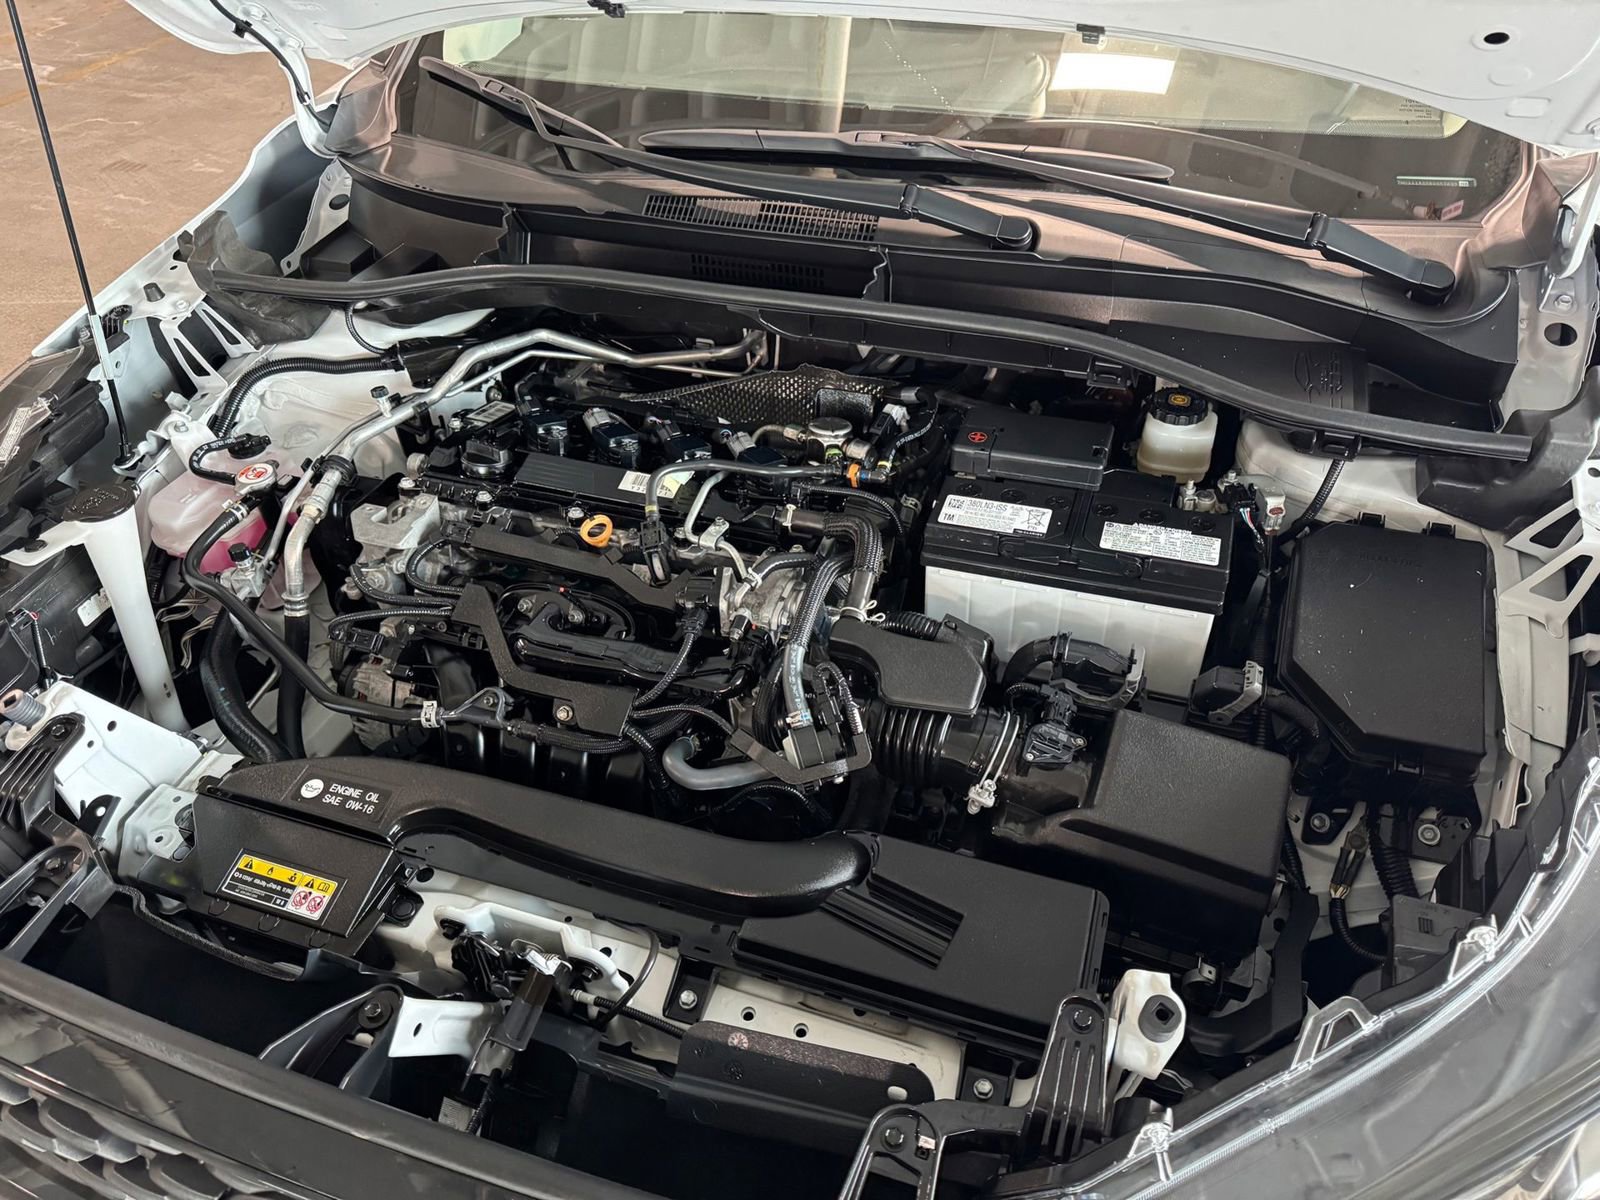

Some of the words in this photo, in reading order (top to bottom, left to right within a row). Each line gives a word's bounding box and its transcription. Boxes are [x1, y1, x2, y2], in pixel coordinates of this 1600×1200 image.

[329, 783, 364, 799] ENGINE
[365, 792, 380, 803] OIL
[322, 794, 343, 806] SAE
[345, 800, 375, 814] 0W-16
